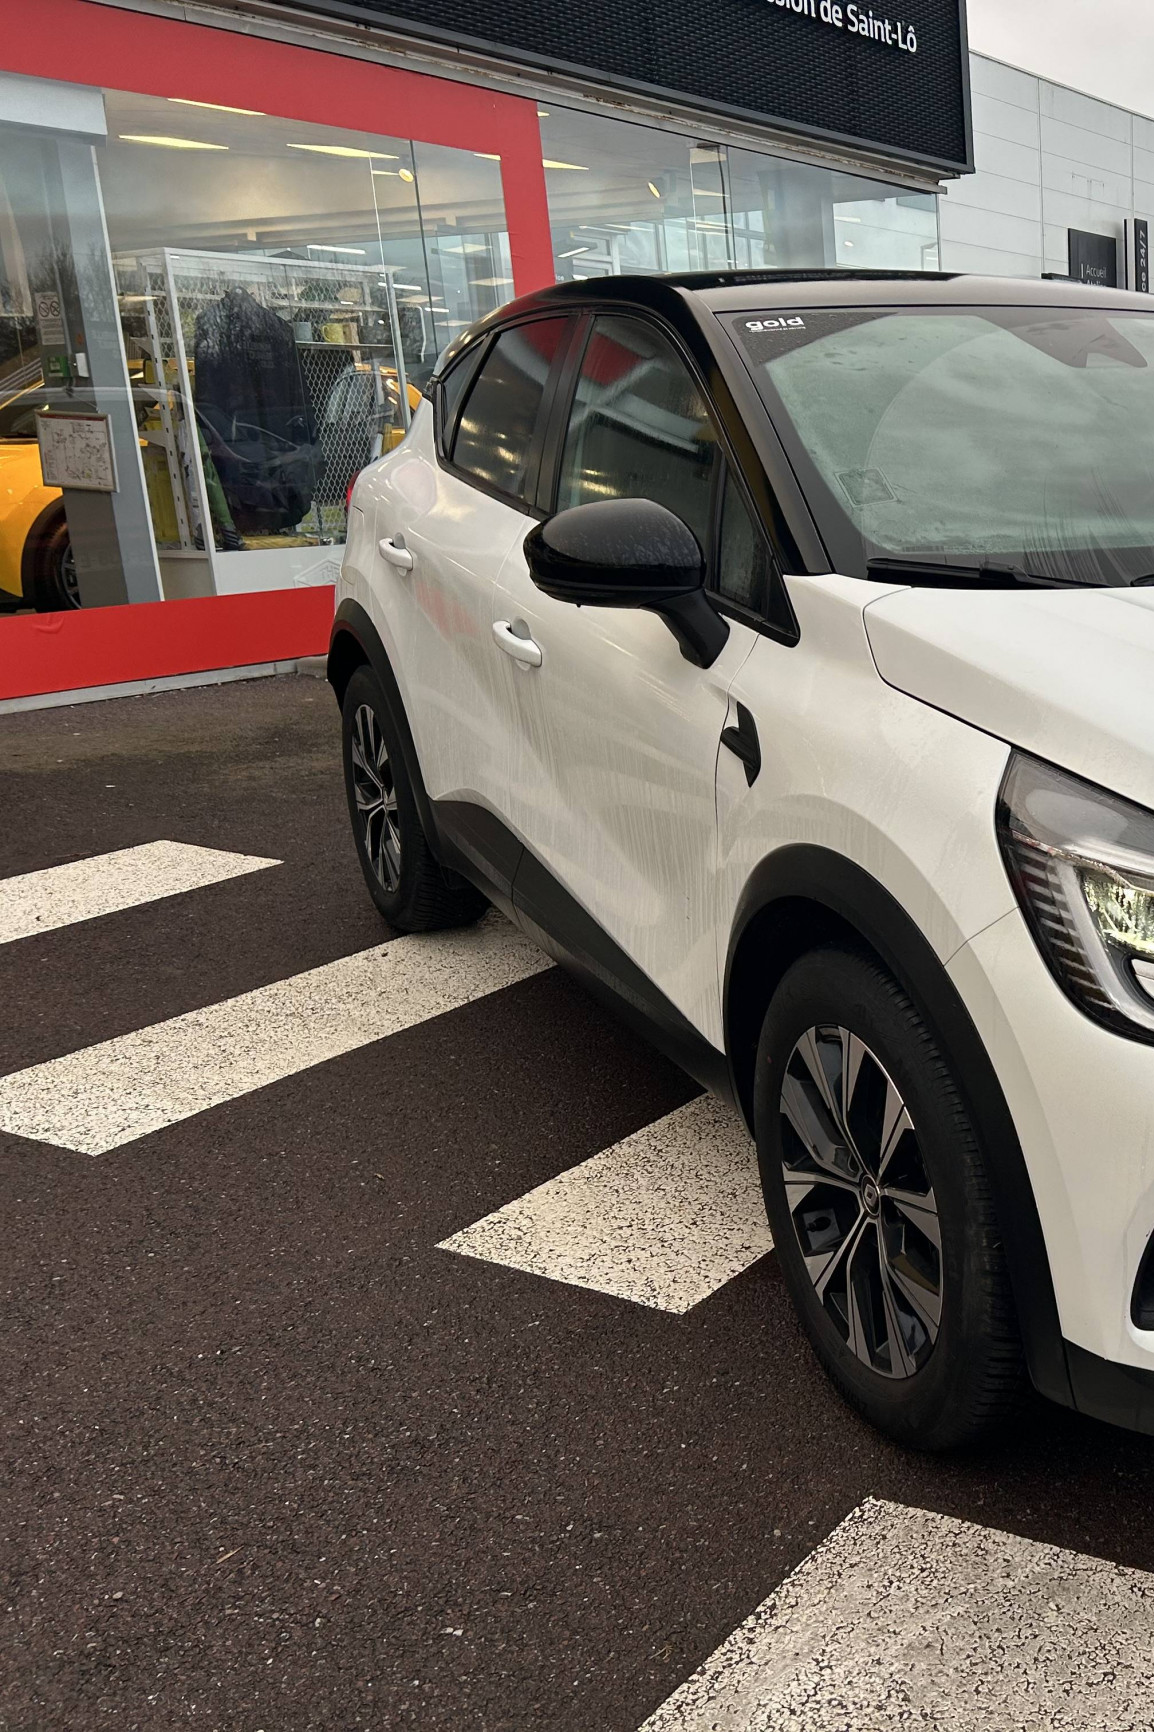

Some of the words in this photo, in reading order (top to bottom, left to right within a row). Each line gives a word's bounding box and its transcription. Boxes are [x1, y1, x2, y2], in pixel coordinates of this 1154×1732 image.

[819, 0, 843, 27] de
[846, 4, 918, 53] Saint-Lô
[1139, 230, 1147, 267] 24/7
[1086, 264, 1107, 278] Accueil
[745, 316, 805, 331] gold
